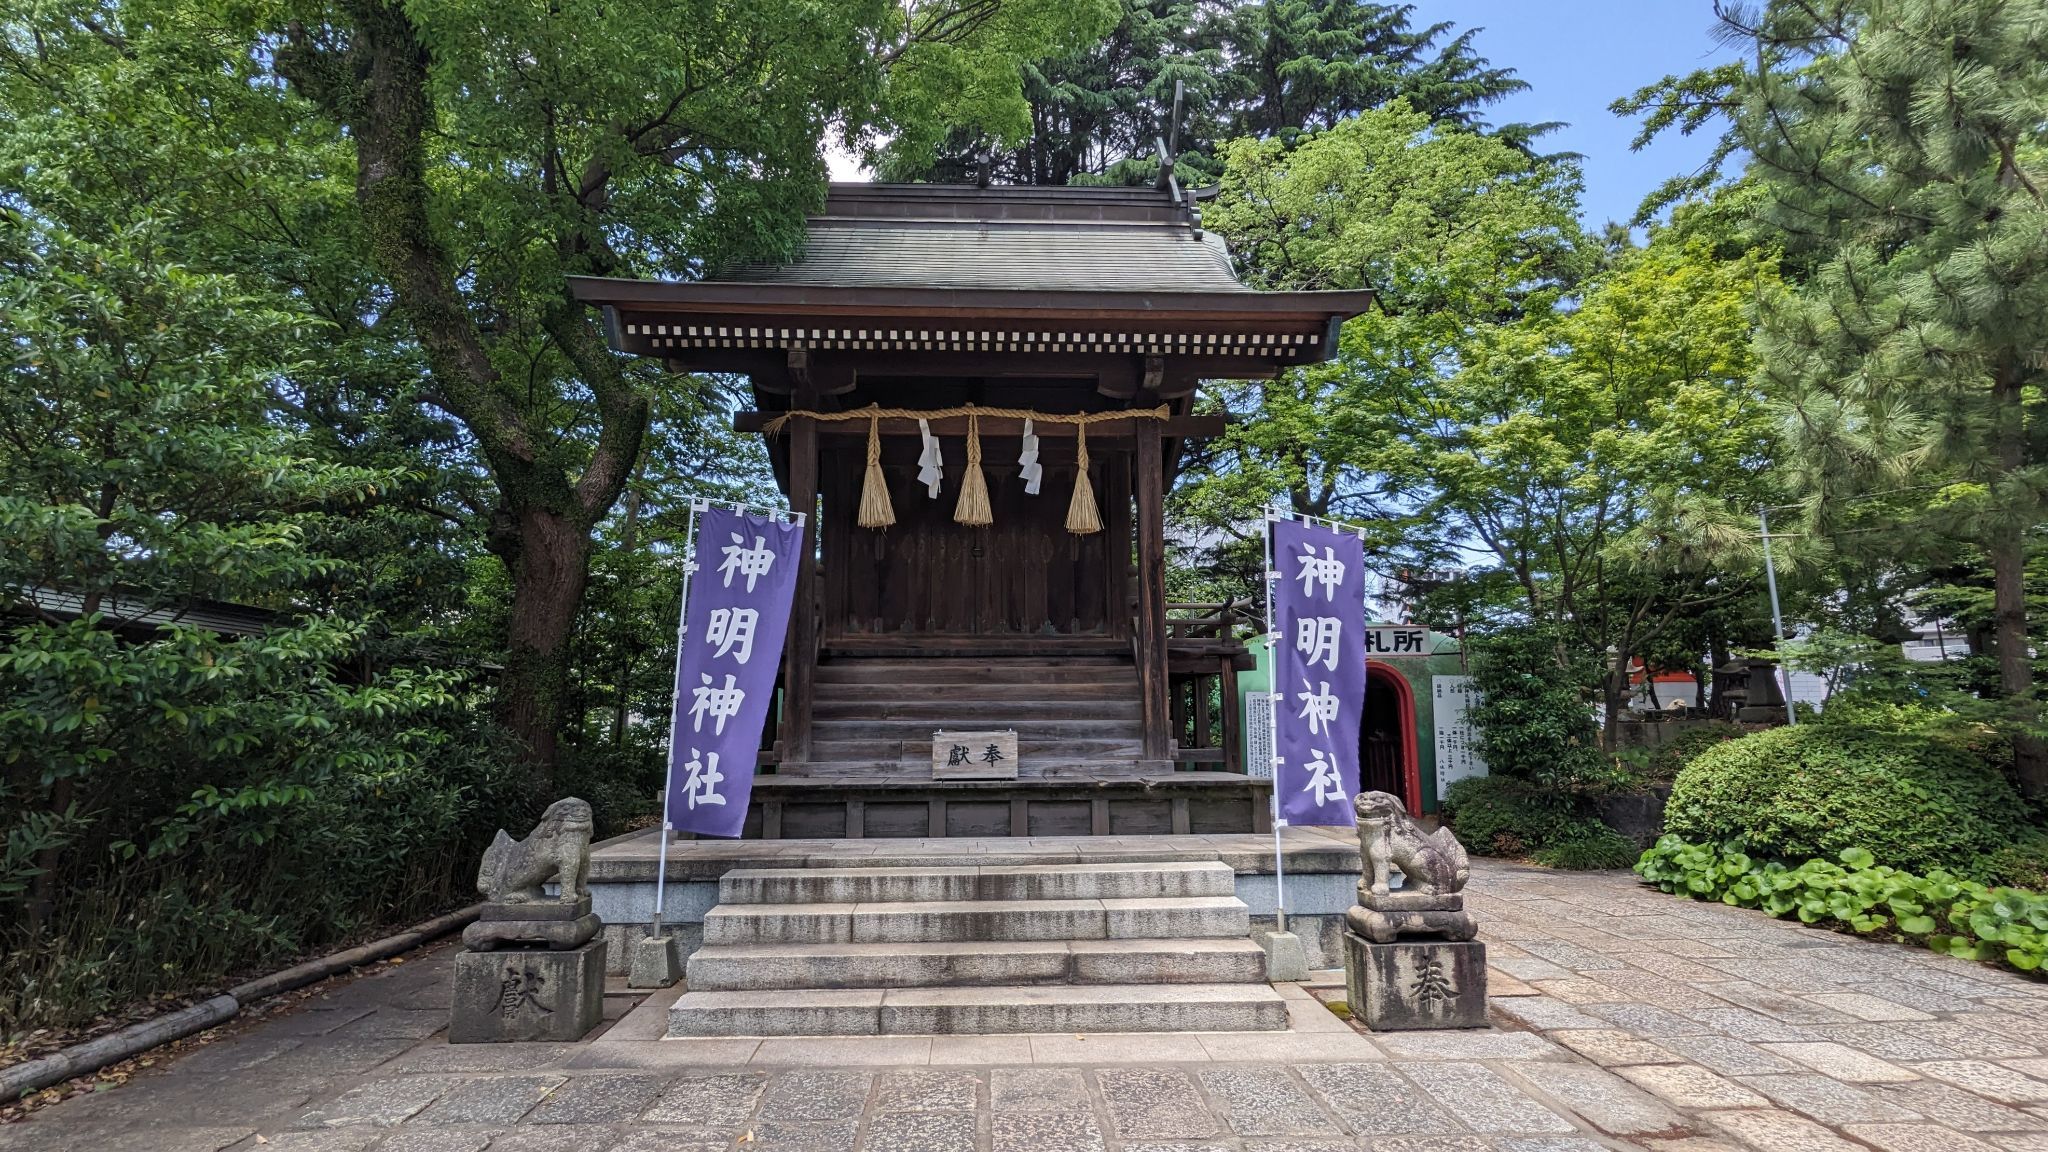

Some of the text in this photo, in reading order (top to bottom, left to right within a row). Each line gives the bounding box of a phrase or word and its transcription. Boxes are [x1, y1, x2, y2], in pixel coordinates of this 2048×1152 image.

[682, 532, 776, 810] 神明神社
[1295, 542, 1345, 807] 神明神社
[1408, 954, 1462, 1013] 奉
